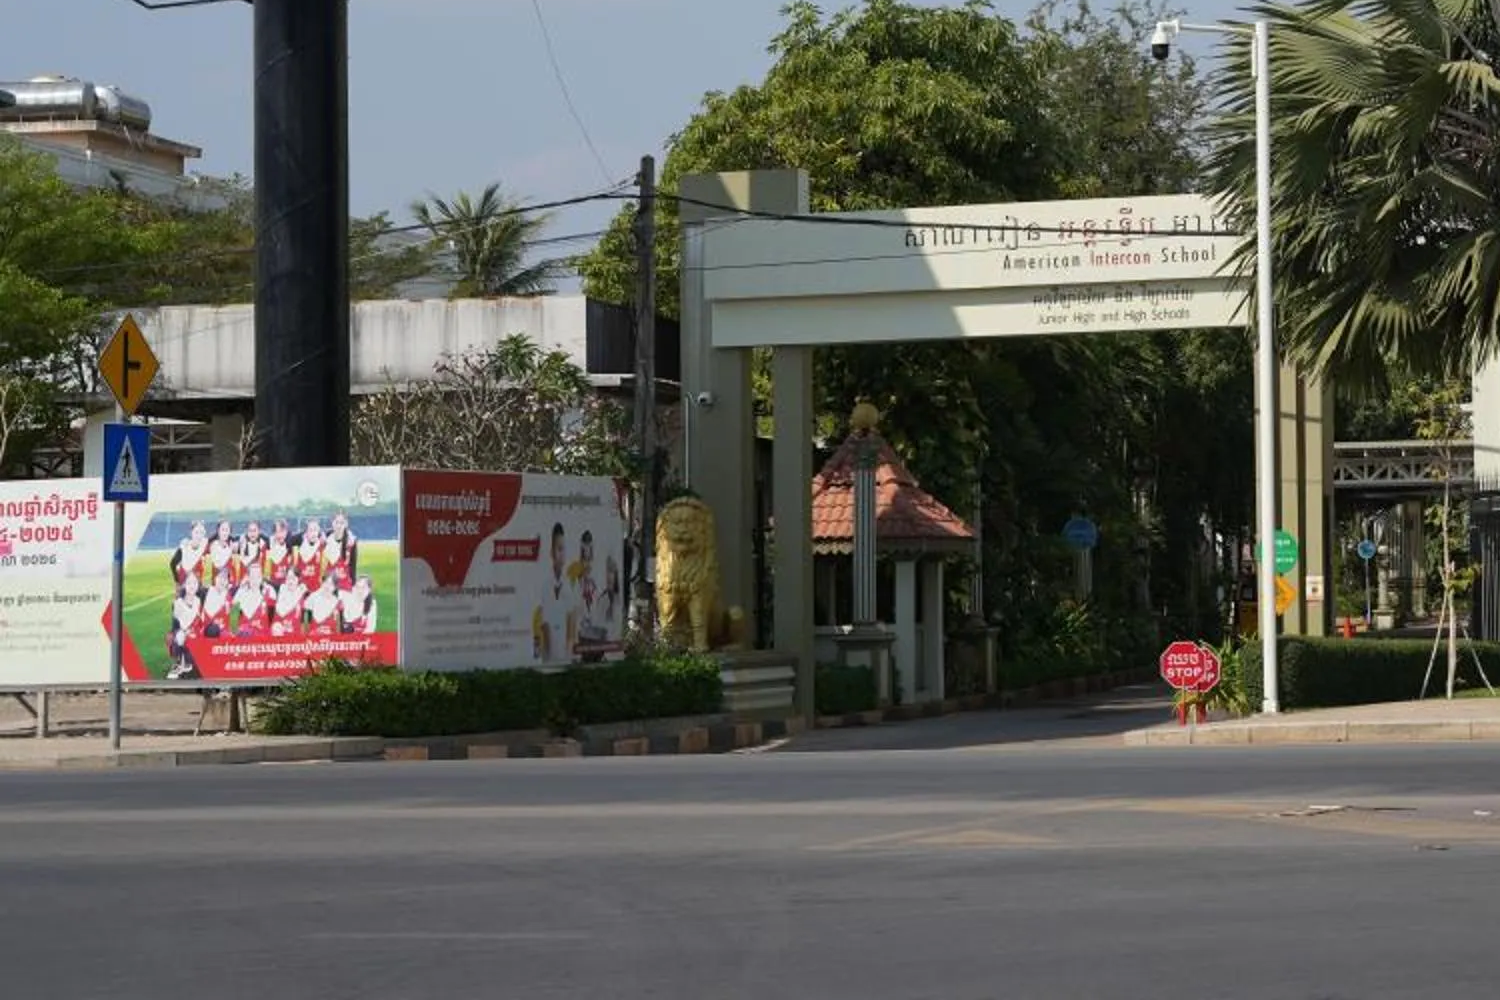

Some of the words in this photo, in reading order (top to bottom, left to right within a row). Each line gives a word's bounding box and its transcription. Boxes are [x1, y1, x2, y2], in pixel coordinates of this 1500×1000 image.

[1003, 254, 1081, 270] American
[1090, 251, 1151, 266] Intercon
[1161, 243, 1216, 263] School
[1124, 308, 1147, 323] High
[1152, 306, 1190, 321] Schools
[1167, 667, 1202, 678] STOP
